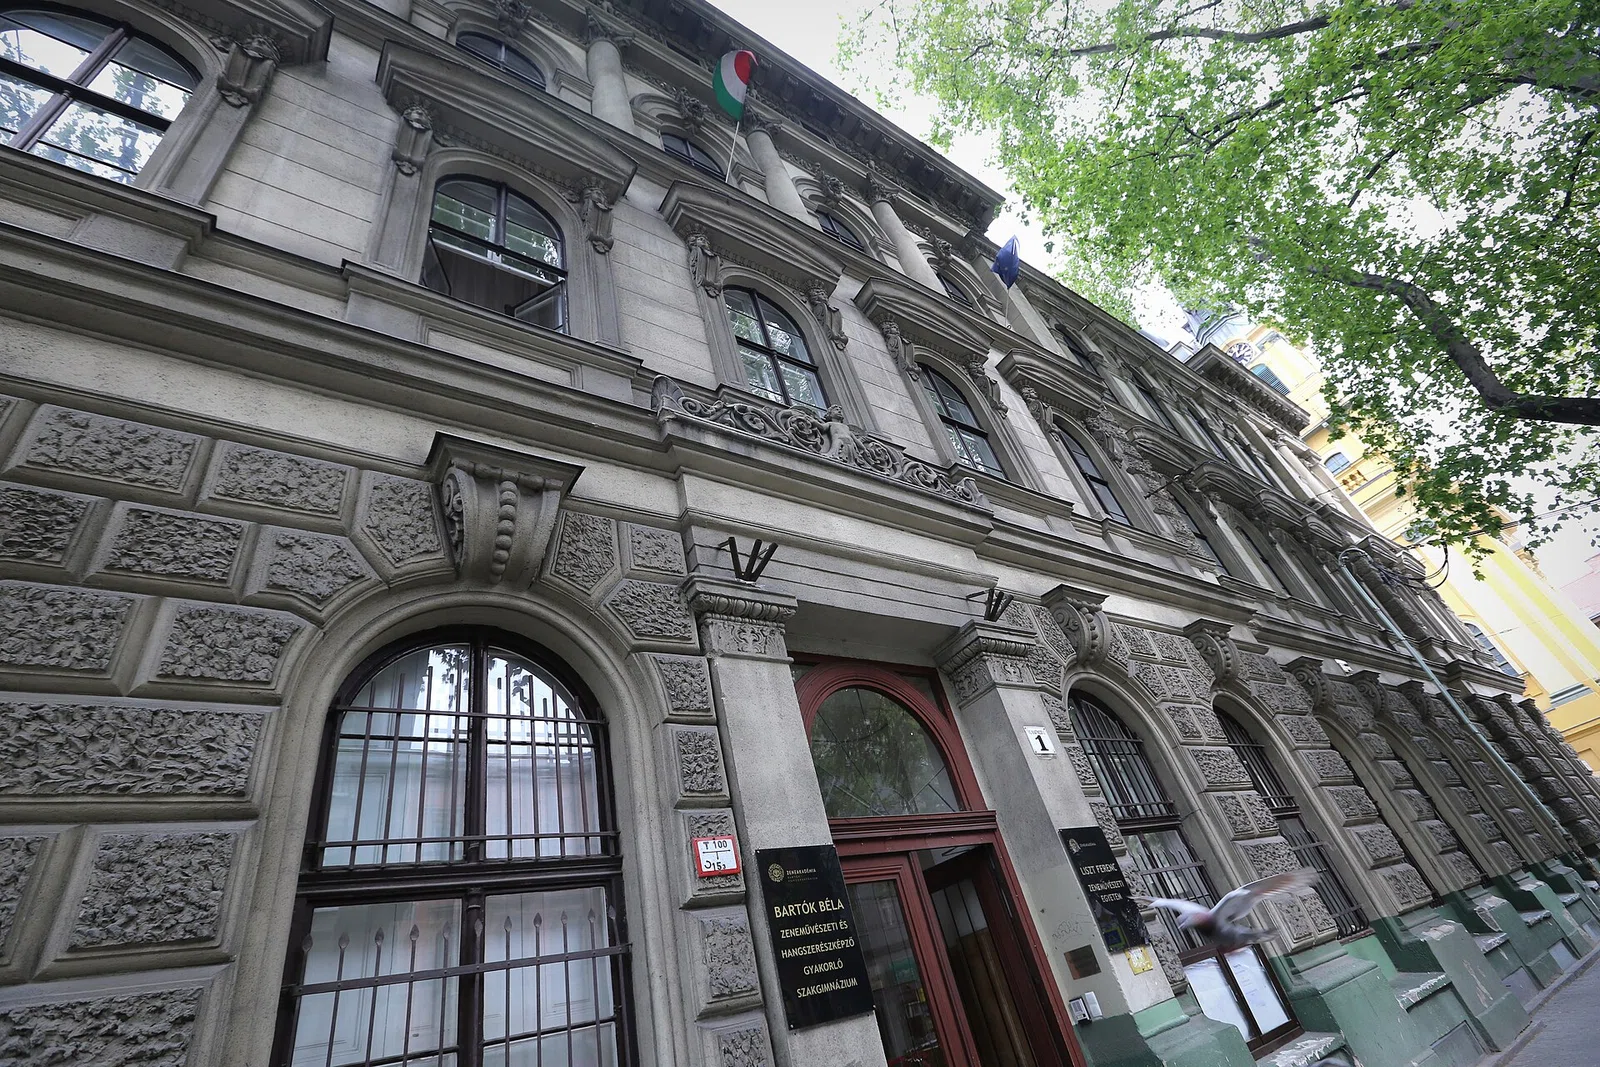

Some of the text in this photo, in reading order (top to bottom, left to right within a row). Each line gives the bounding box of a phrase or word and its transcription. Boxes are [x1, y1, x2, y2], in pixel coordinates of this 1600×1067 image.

[1035, 735, 1049, 751] 1
[703, 840, 727, 850] T 100
[1080, 863, 1117, 875] LISZT FERENC
[1100, 892, 1123, 902] EGYETEM
[774, 897, 844, 918] BARTÓK BÉLA
[780, 919, 848, 938] ZENEMŰVÉSZETI ÉS
[781, 937, 855, 958] HANGSZERÉSZKÉPZŐ
[803, 958, 843, 975] GYAKORLÓ
[797, 978, 858, 998] SZAKGIMNÁZIUM
